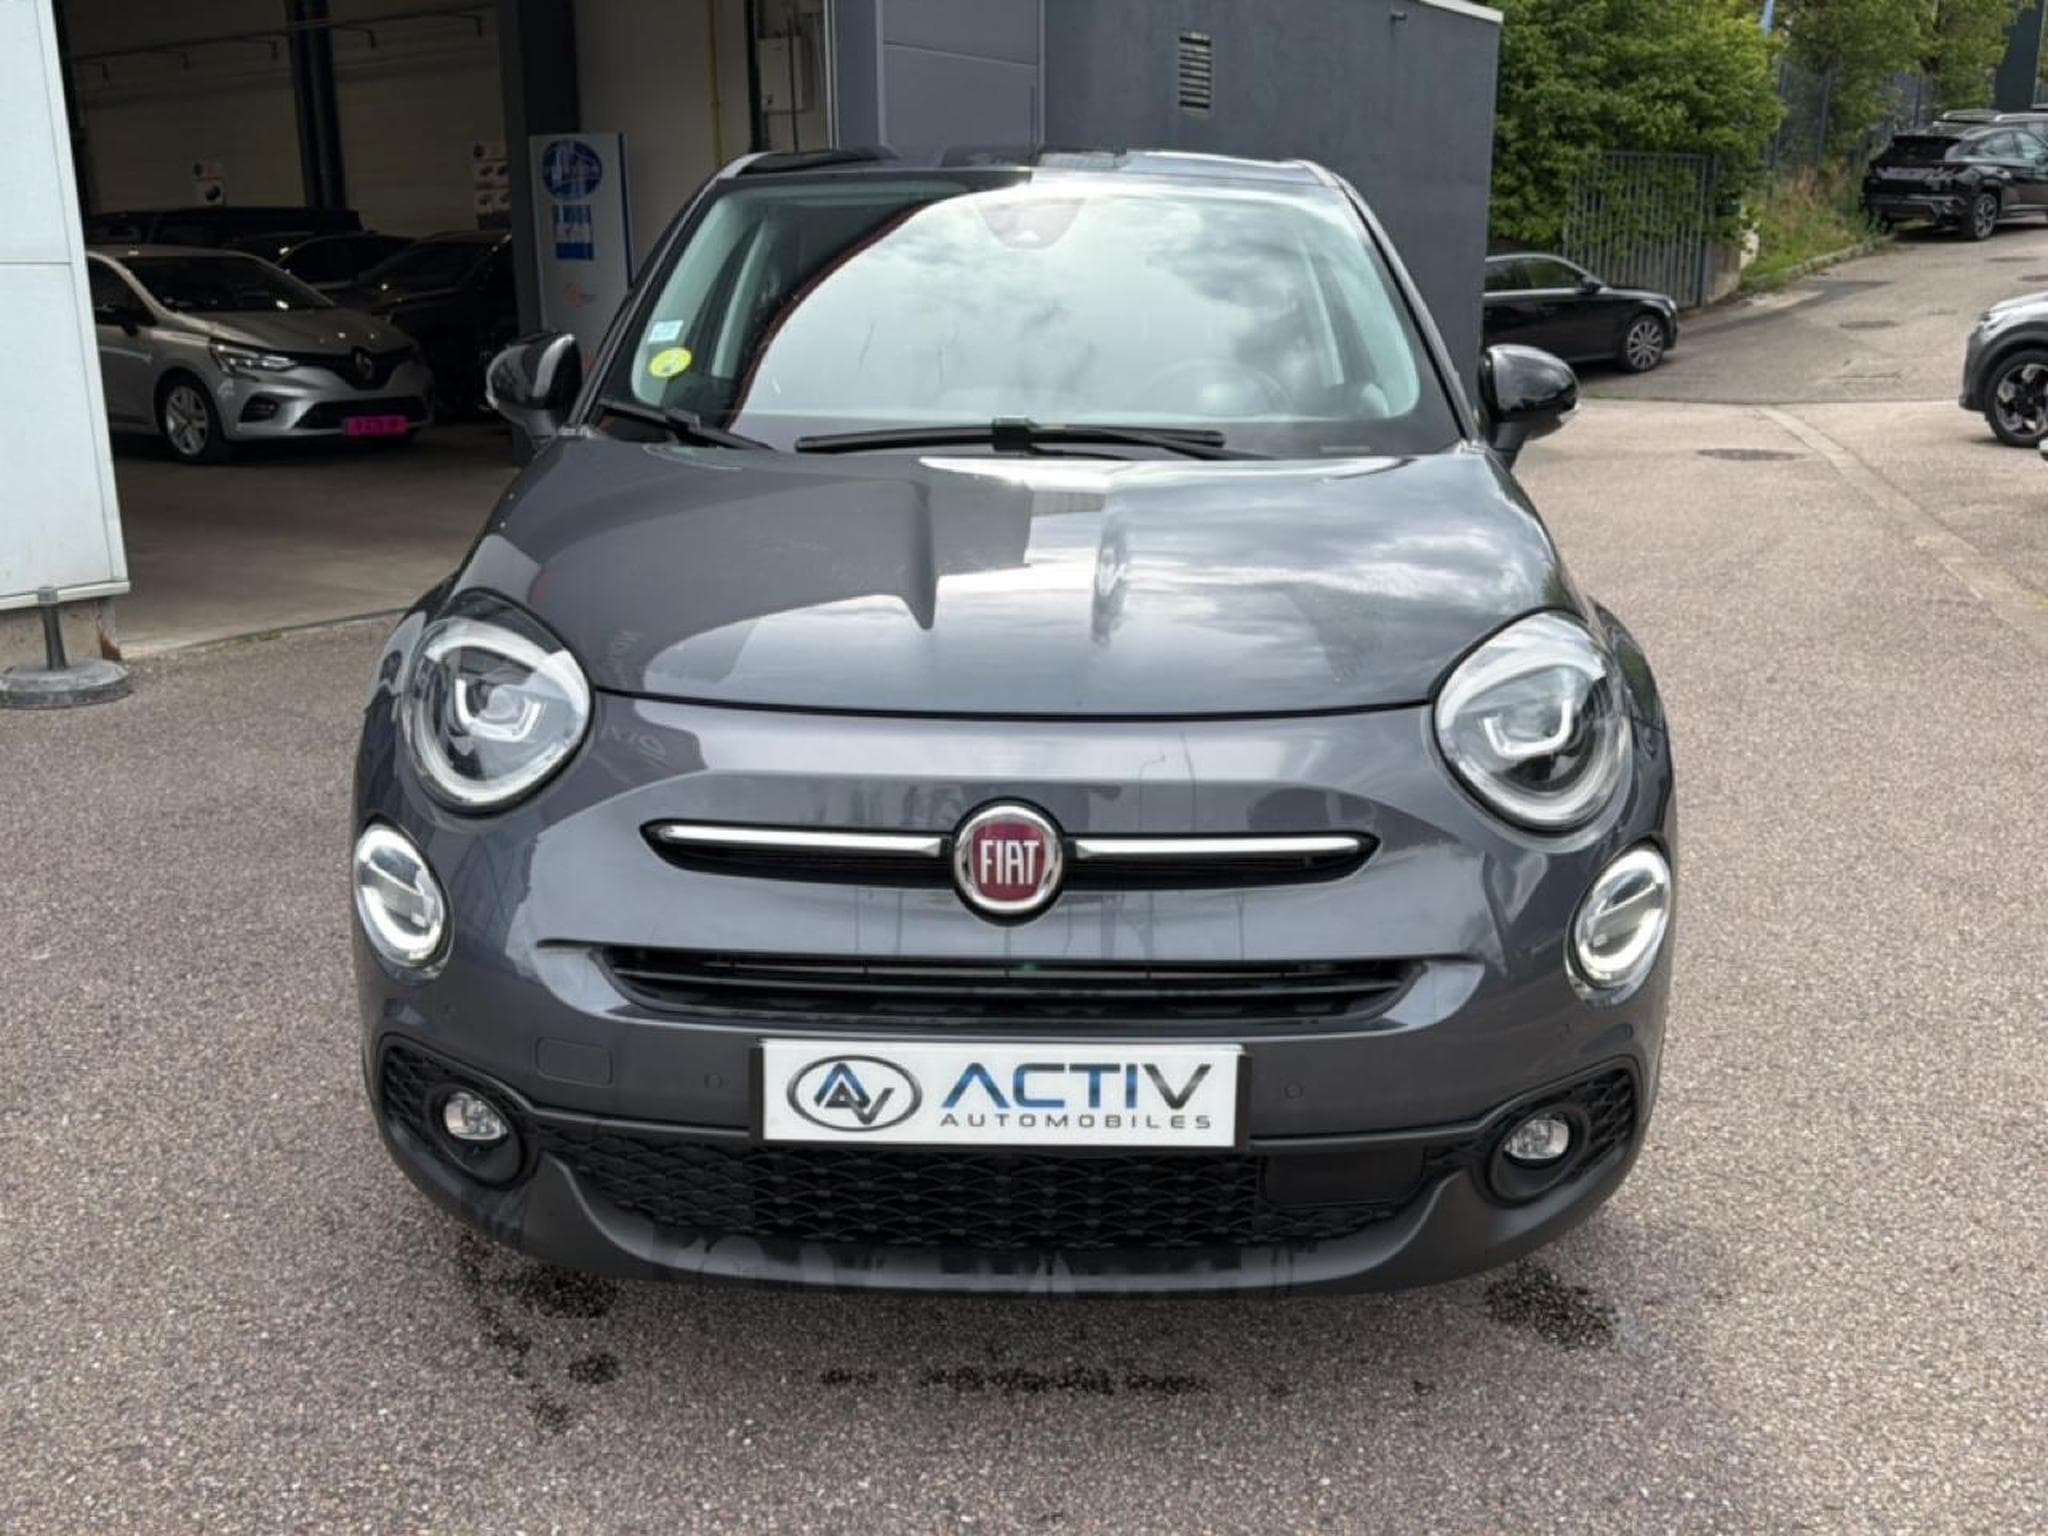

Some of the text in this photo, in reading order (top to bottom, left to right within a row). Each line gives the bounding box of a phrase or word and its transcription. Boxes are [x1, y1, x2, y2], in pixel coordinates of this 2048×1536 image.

[981, 839, 1040, 885] FIAT
[940, 1062, 1213, 1110] ACTIV
[939, 1113, 1211, 1129] AUTOMOBILES
